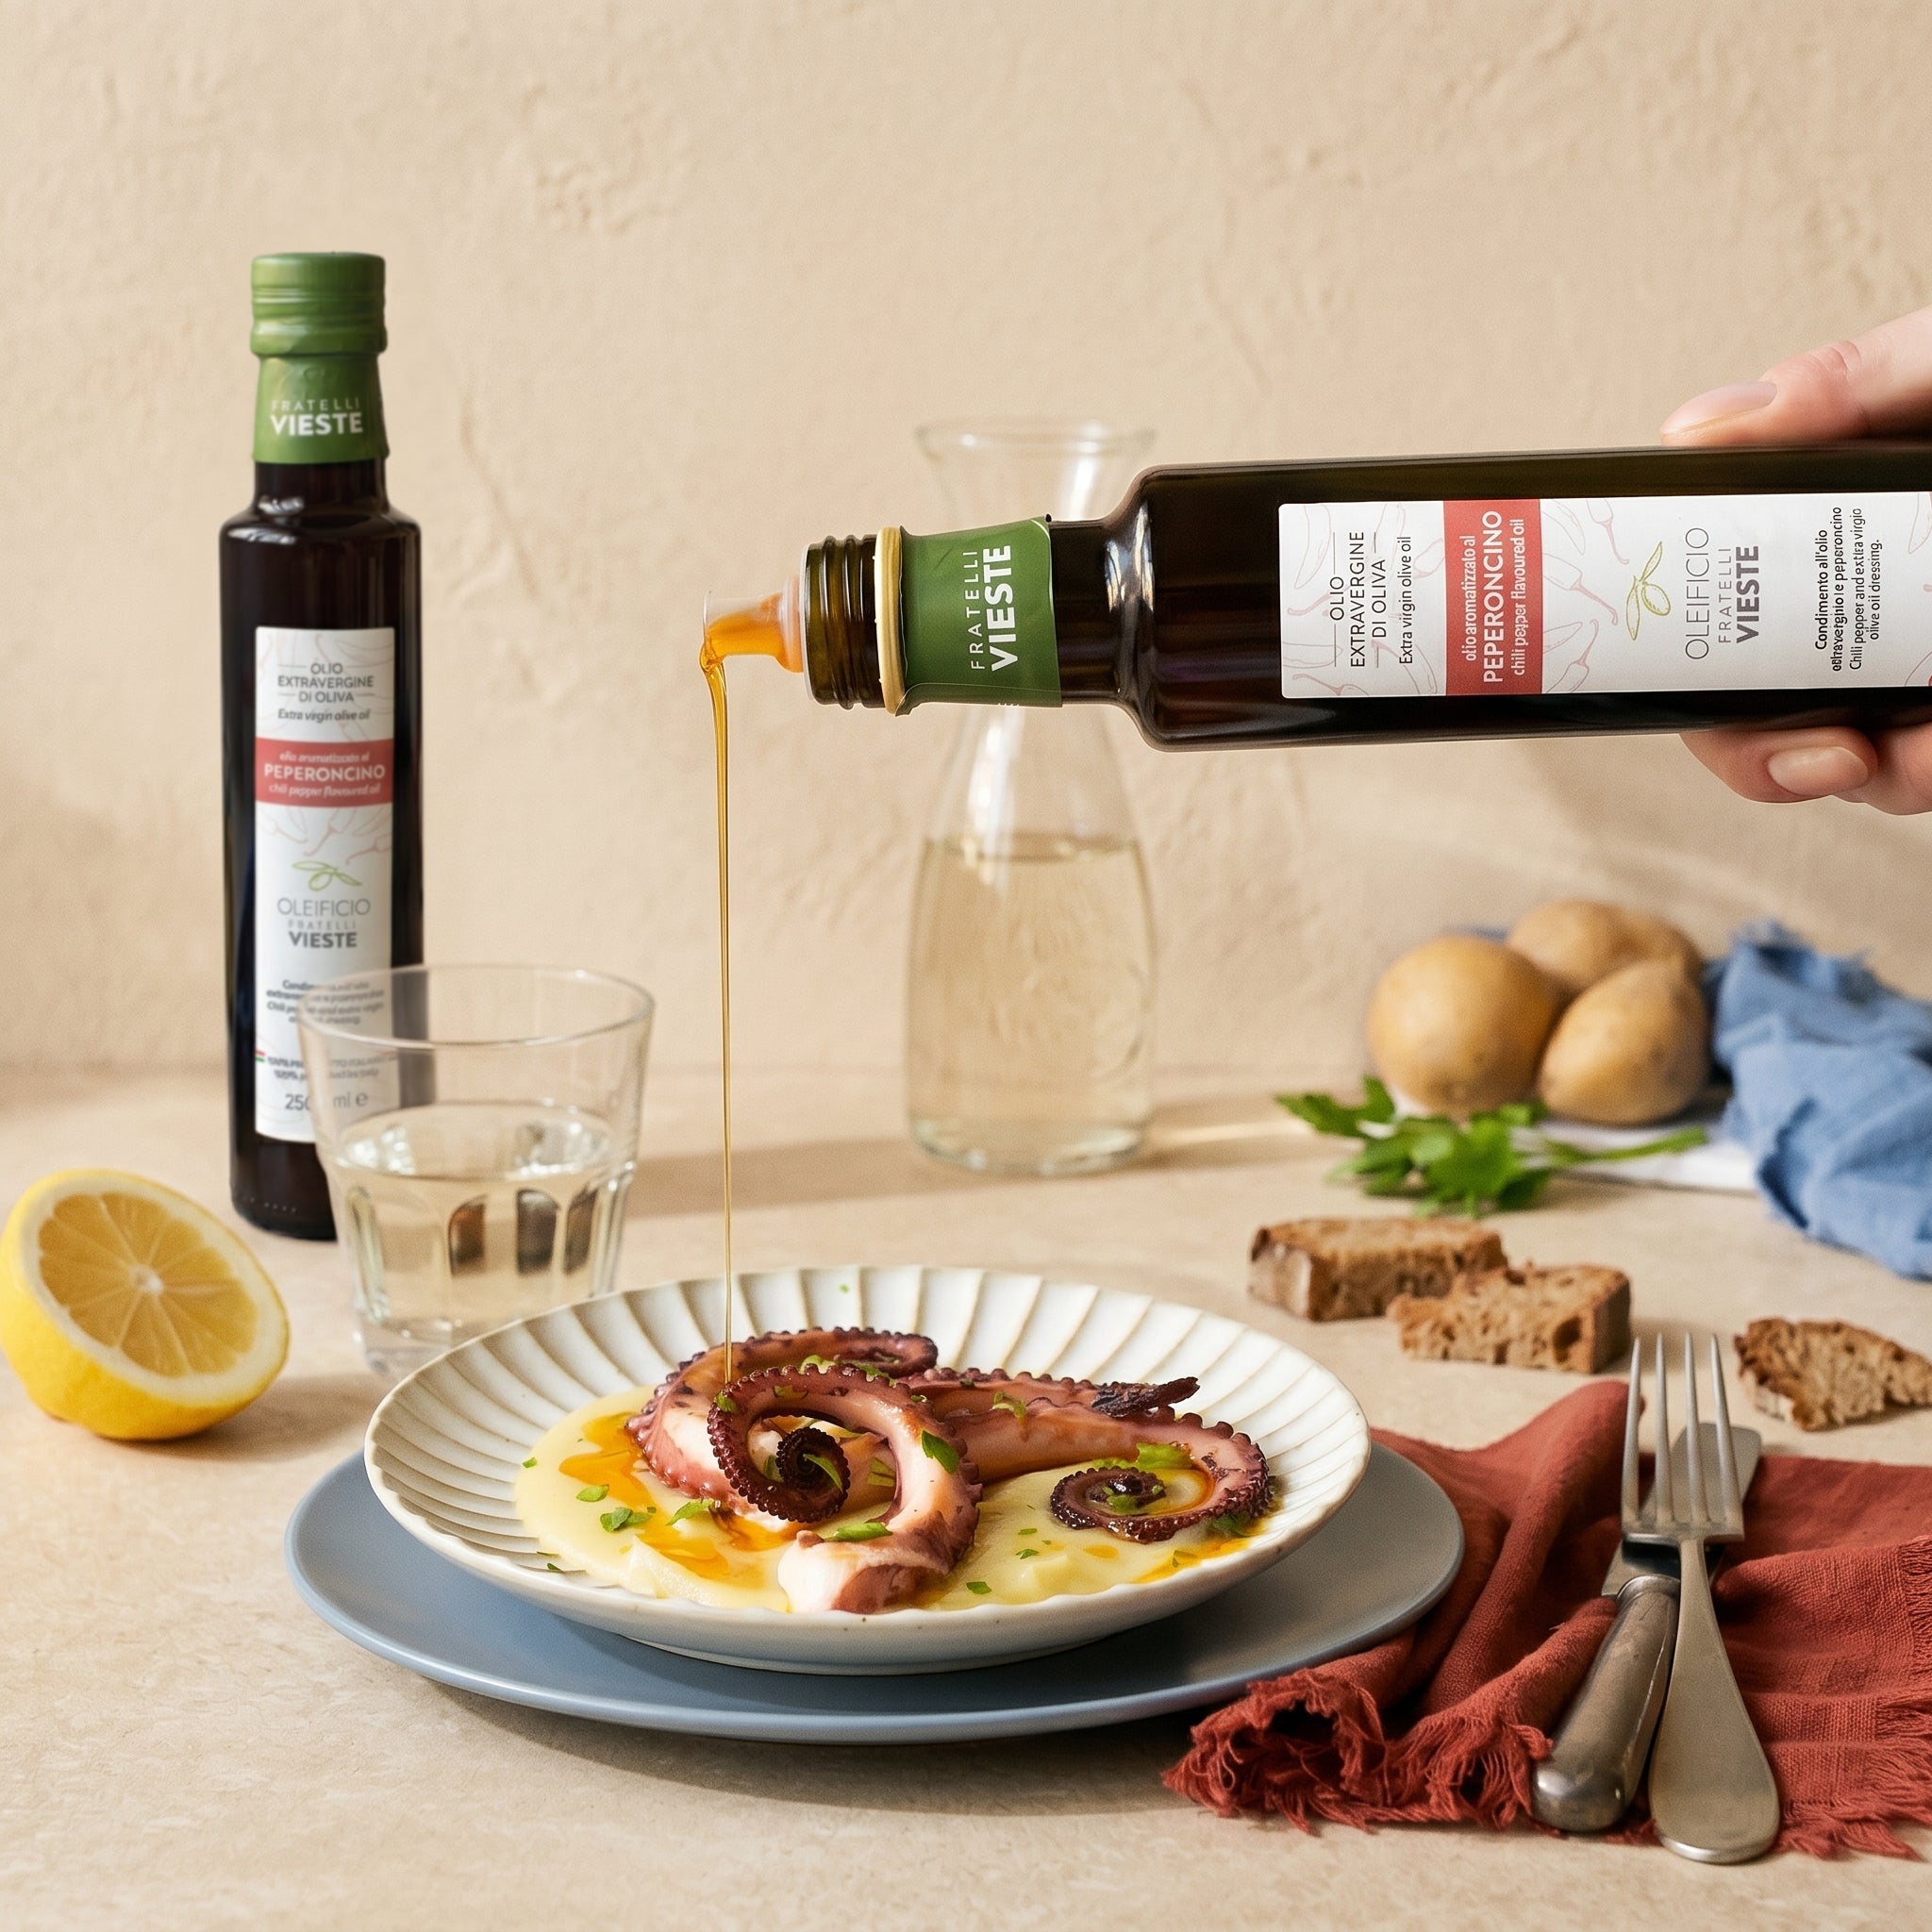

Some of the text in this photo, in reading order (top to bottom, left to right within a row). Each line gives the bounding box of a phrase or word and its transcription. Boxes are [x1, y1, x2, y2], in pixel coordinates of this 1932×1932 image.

[271, 397, 359, 412] FRATELLI
[270, 412, 364, 437] VIESTE
[1509, 519, 1525, 536] oil
[1329, 576, 1345, 621] OLIO
[1349, 531, 1366, 667] EXTRAVERGINE
[1371, 559, 1387, 639] DI OLIVA
[1396, 536, 1416, 664] Extra virgin olive oil
[1482, 510, 1505, 683] PEPERONCINO
[1685, 527, 1709, 659] OLEIFICIO
[1718, 548, 1732, 644] FRATELLI
[1736, 545, 1759, 644] VIESTE
[1814, 530, 1828, 650] Condimento all'olio
[1851, 576, 1865, 600] and
[963, 551, 986, 670] FRATELLI
[983, 545, 1019, 672] VIESTE
[1854, 603, 1867, 643] pepper
[309, 662, 343, 675] OLIO
[1511, 649, 1525, 675] chili
[1849, 646, 1863, 670] Chili
[277, 675, 375, 689] EXTRAVERGINE
[298, 691, 355, 703] DI OLIVA
[277, 708, 303, 720] Extra
[305, 709, 333, 724] virgin
[264, 762, 386, 782] PEPERONCINO
[277, 897, 371, 917] OLEIFICIO
[288, 919, 357, 931] FRATELLI
[289, 931, 358, 948] VIESTE
[333, 1091, 351, 1108] ml
